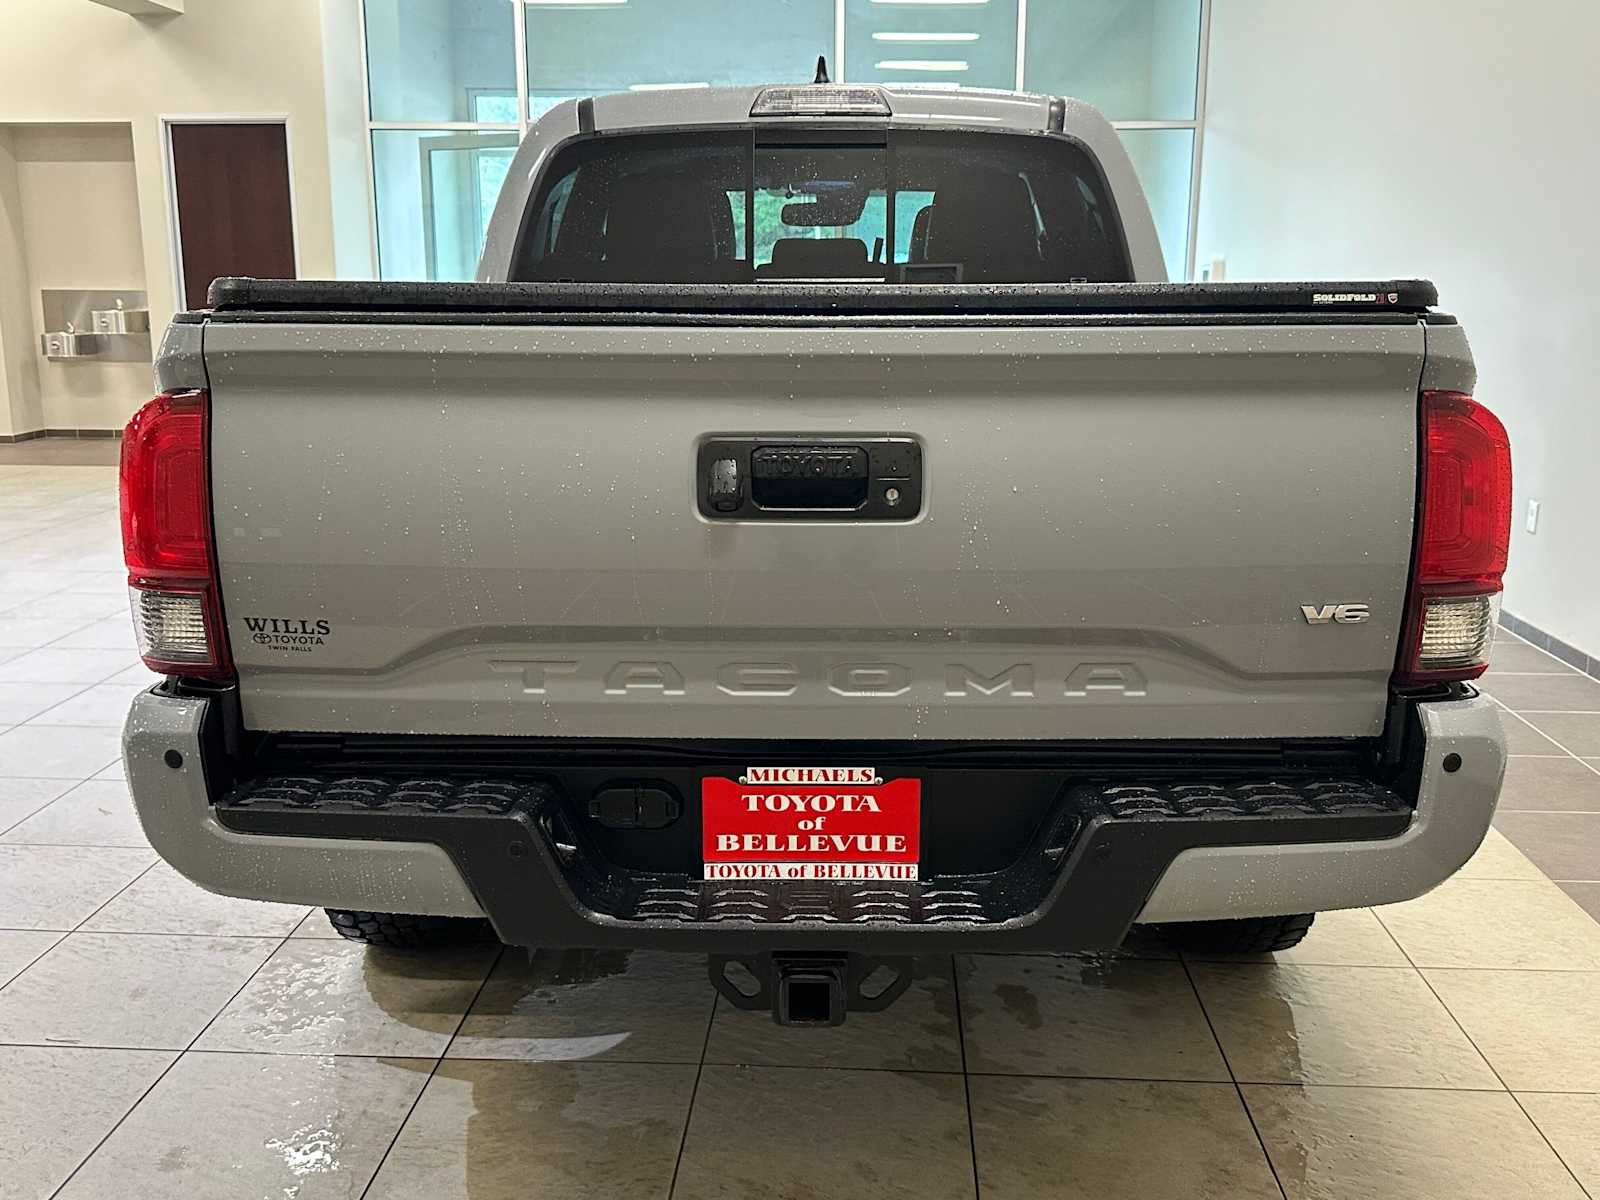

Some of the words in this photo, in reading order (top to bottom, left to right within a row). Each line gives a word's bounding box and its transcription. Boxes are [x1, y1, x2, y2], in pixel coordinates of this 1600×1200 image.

[1313, 293, 1376, 302] SOLIDFOLD
[761, 454, 856, 476] TOYOTA
[1300, 604, 1370, 624] V6
[243, 617, 330, 635] WILLS
[272, 634, 324, 645] TOYOTA
[490, 660, 1147, 697] TACOMA
[750, 769, 873, 782] MICHAELS
[741, 794, 882, 812] TOYOTA
[797, 816, 826, 831] of
[716, 834, 907, 852] BELLEVUE
[706, 864, 781, 878] TOYOTA
[787, 864, 807, 878] of
[813, 865, 916, 879] BELLEVUE
